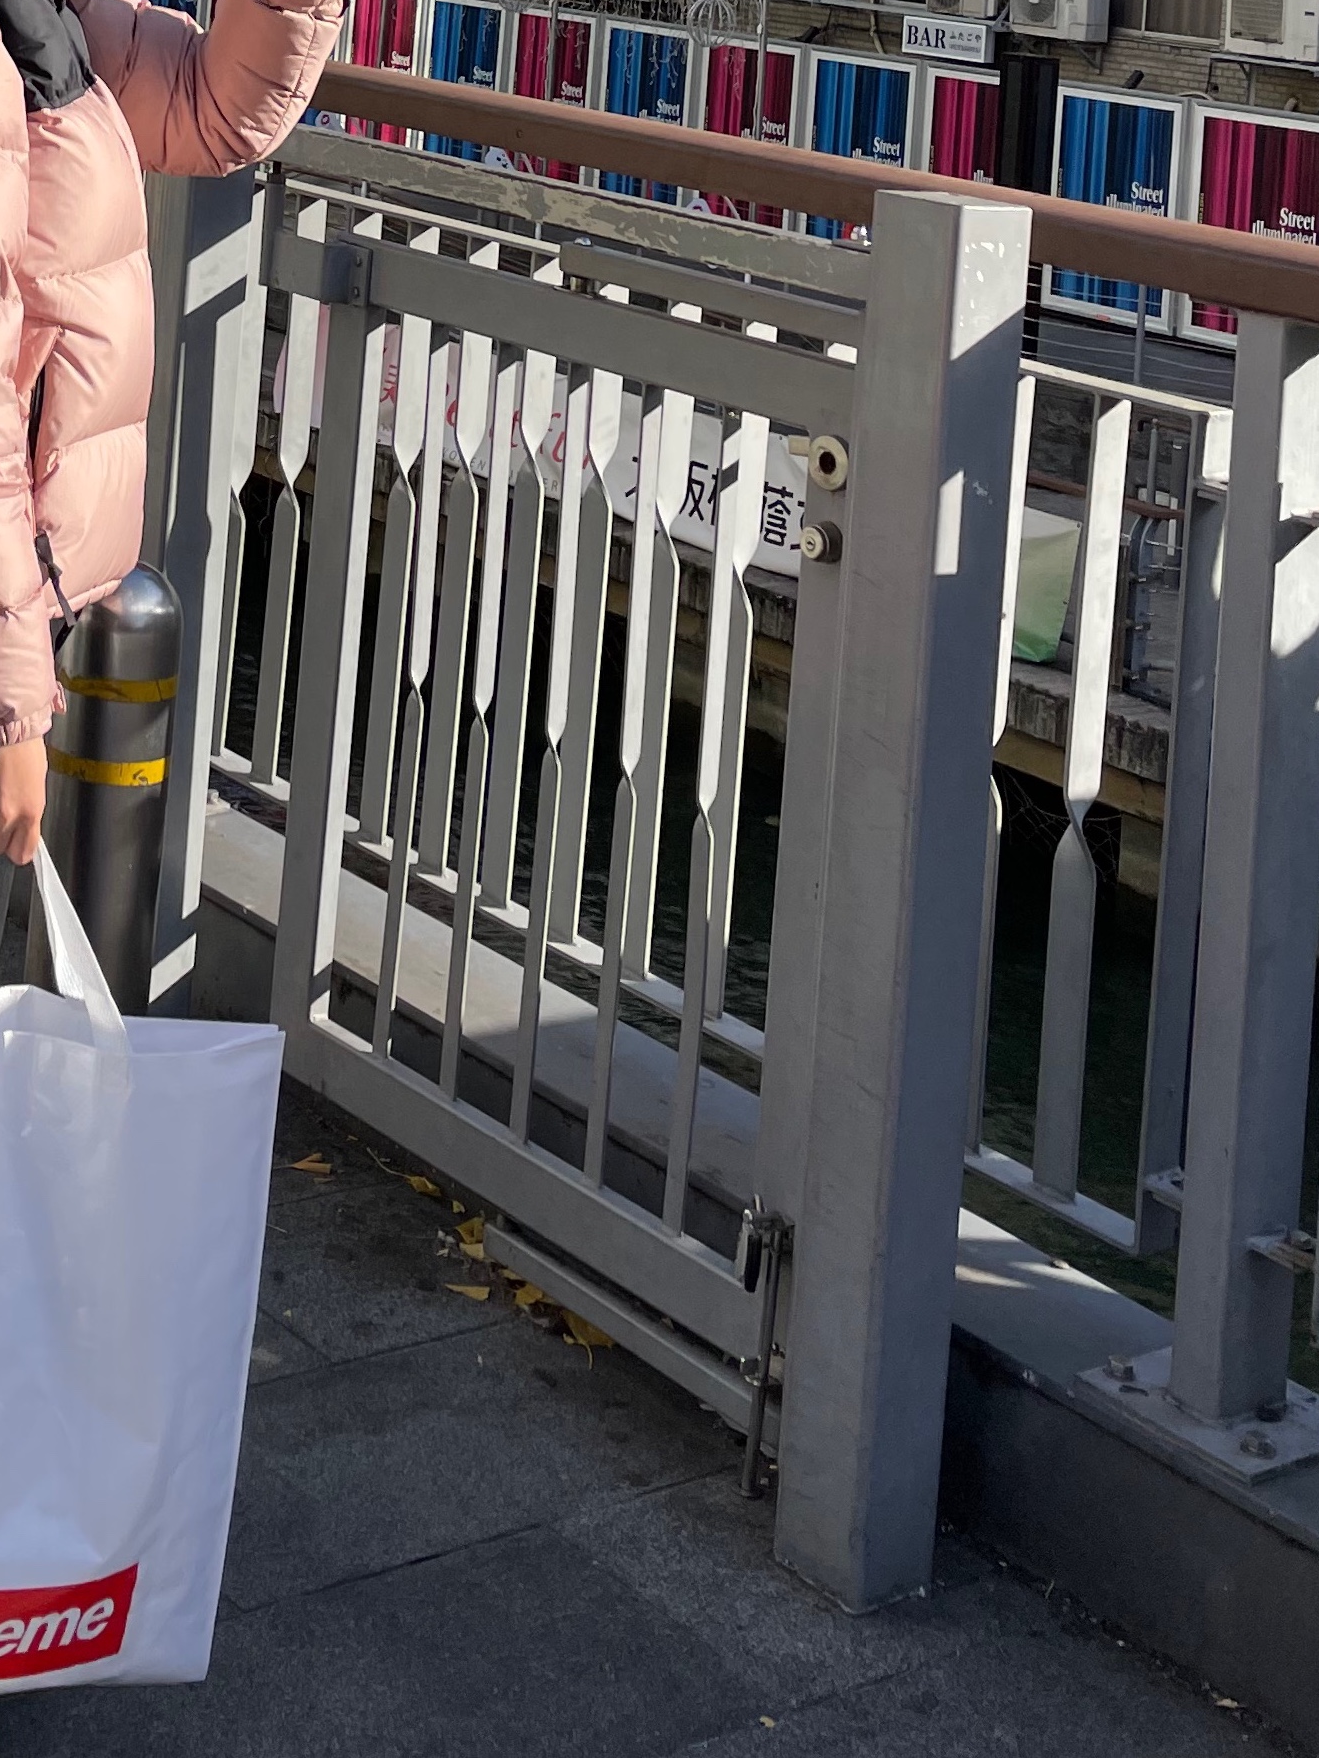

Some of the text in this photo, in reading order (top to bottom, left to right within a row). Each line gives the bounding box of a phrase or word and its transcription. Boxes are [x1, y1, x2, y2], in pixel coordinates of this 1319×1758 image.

[907, 24, 946, 50] BAR
[656, 98, 680, 115] Street
[762, 115, 785, 135] Street
[873, 137, 900, 157] Street
[1131, 181, 1163, 204] Street
[1279, 207, 1315, 230] Street
